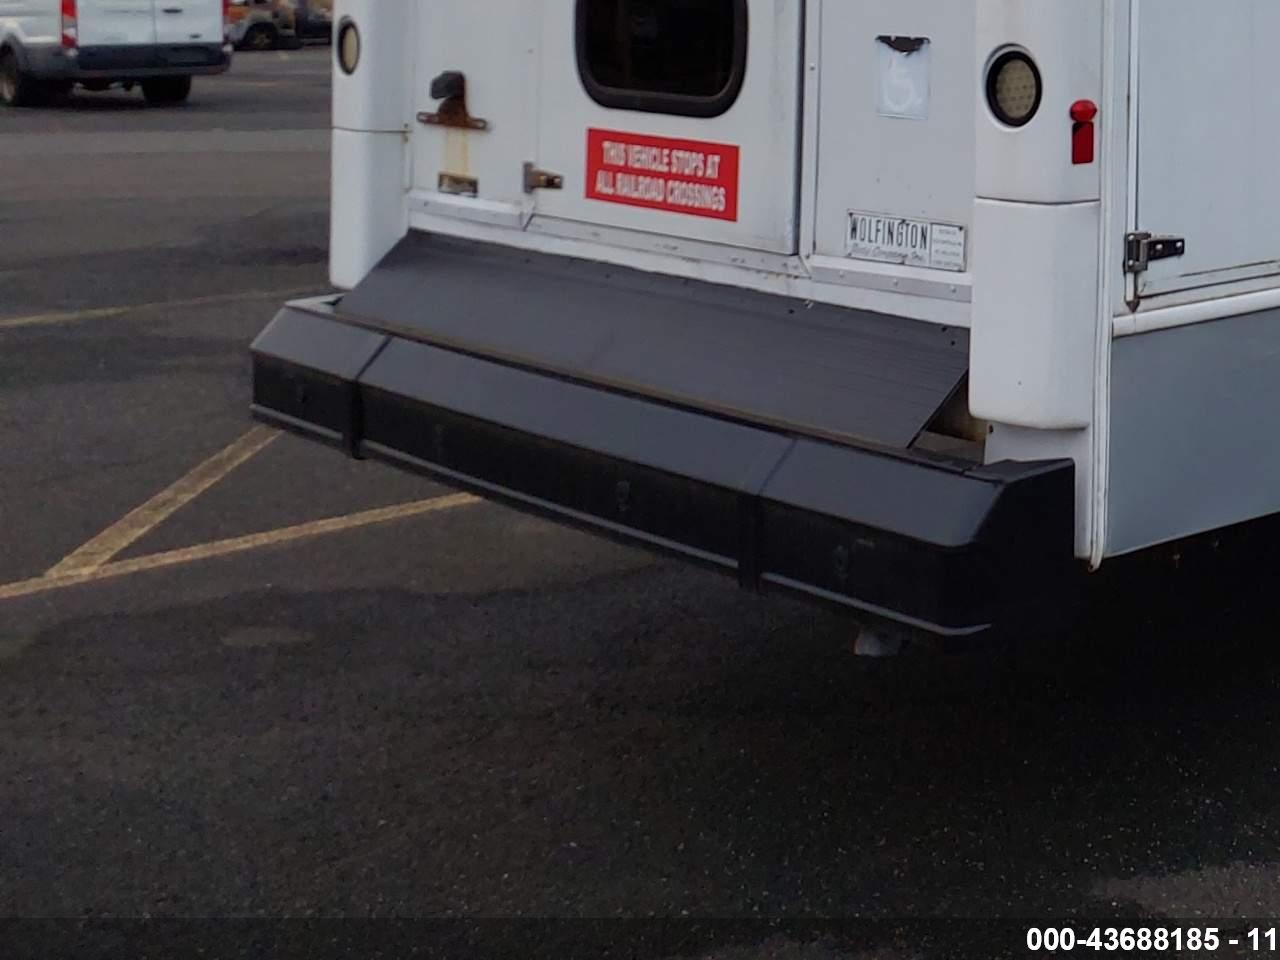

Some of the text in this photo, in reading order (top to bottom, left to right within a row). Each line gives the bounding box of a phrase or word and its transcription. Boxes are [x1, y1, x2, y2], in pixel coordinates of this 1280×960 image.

[602, 141, 720, 179] THIS VEHICLE STOPS AT
[595, 170, 726, 211] ALL RAILROAD CROSSINGS
[849, 215, 928, 250] WOLFINGTON
